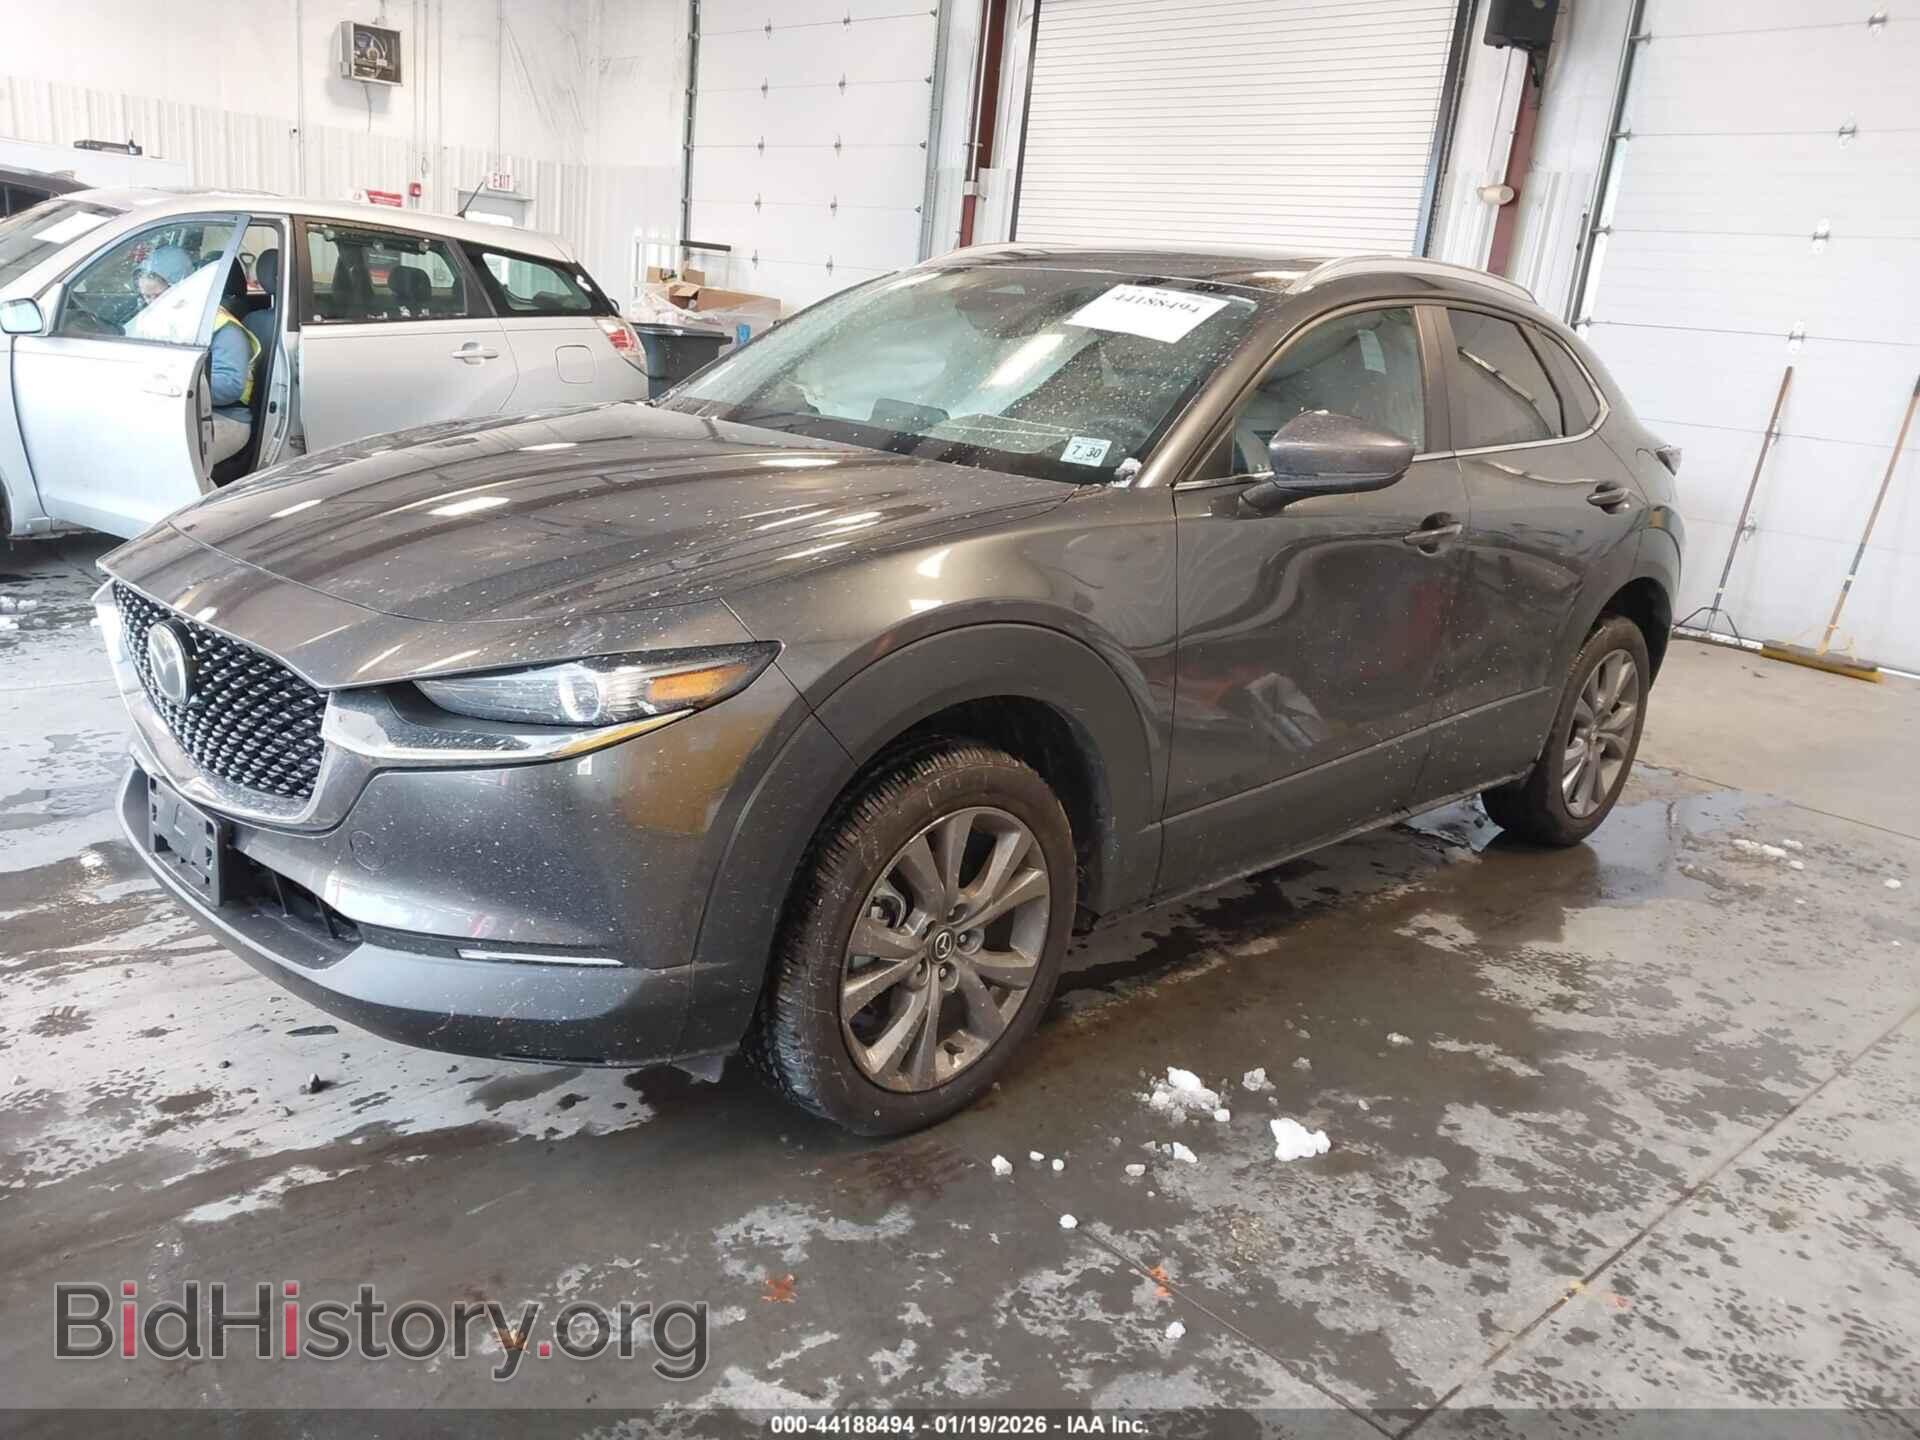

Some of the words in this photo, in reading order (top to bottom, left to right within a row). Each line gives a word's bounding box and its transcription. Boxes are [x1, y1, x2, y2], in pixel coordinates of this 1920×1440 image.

[493, 173, 511, 189] EXIT
[1072, 445, 1083, 455] 7
[1086, 447, 1102, 458] 30
